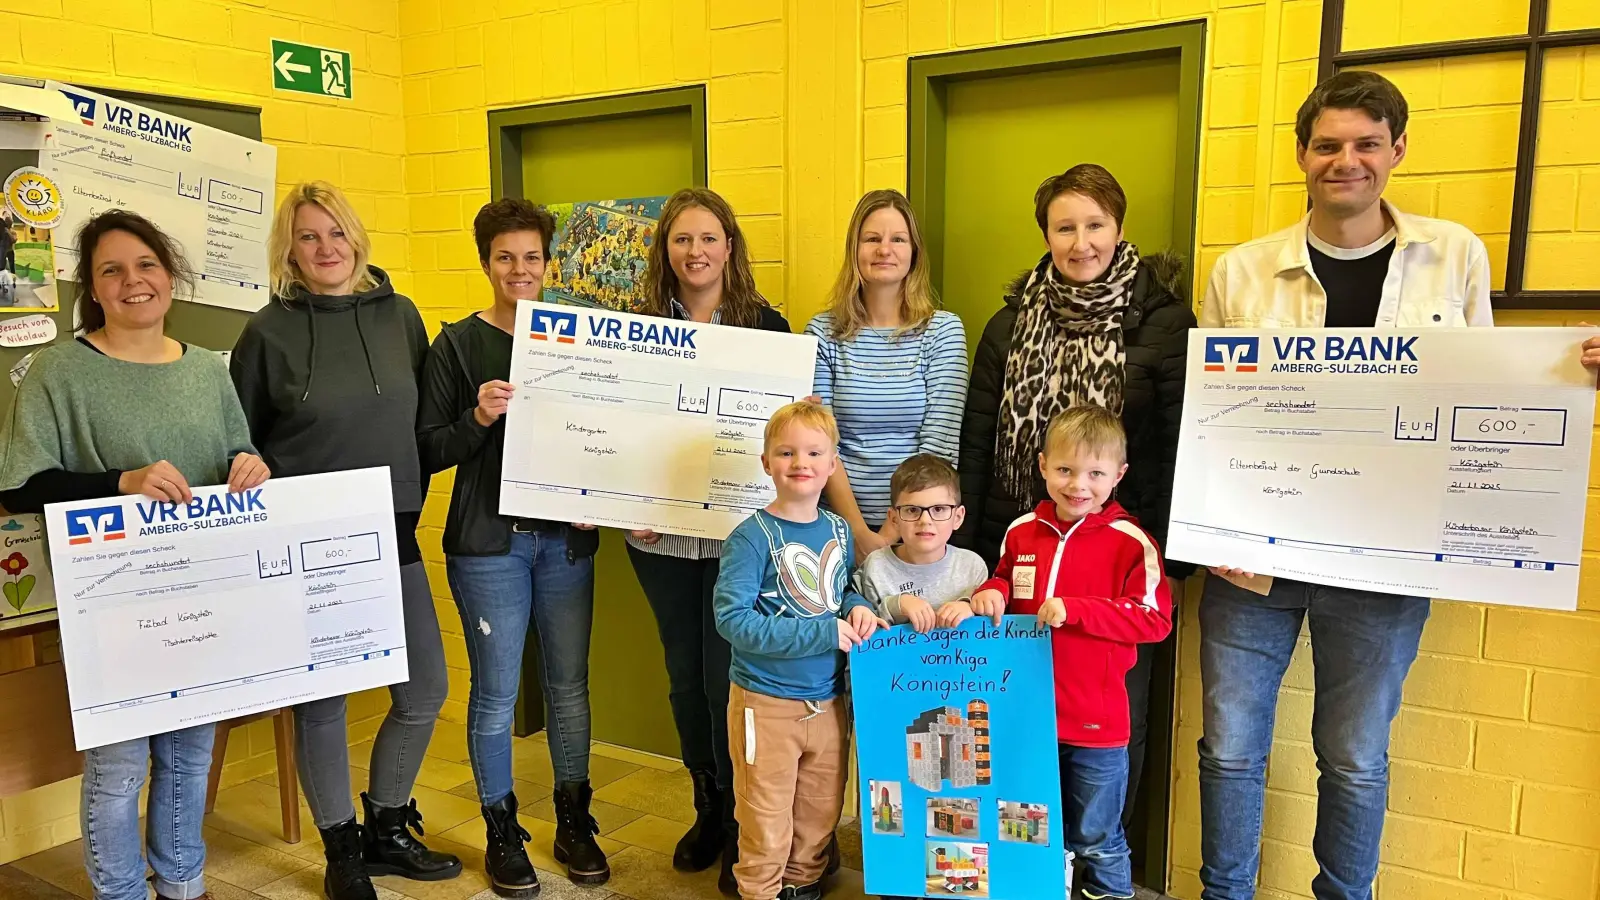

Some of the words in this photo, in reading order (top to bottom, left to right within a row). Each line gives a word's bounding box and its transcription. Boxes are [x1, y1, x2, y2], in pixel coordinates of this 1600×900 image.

[105, 103, 132, 127] VR
[138, 113, 192, 144] BANK
[103, 123, 180, 149] AMBERG-SULZBACH
[181, 182, 199, 192] EUR
[116, 198, 127, 206] der
[26, 206, 52, 216] KLARO
[31, 318, 50, 326] vom
[6, 332, 47, 344] Nikolaus
[588, 316, 622, 340] VR
[628, 321, 697, 349] BANK
[586, 338, 681, 358] AMBERG-SULZBACH
[683, 350, 696, 360] EG
[1272, 336, 1316, 361] VR
[1325, 336, 1419, 362] BANK
[1270, 363, 1397, 374] AMBERG-SULZBACH
[1400, 364, 1418, 374] EG
[681, 396, 706, 406] EUR
[1198, 416, 1208, 424] Nur
[1220, 396, 1259, 415] Verrechnung
[728, 419, 757, 427] Überbringer
[1400, 422, 1433, 432] EUR
[1468, 445, 1510, 454] Überbringer
[1229, 458, 1278, 472] Elternbeirat
[1286, 464, 1302, 472] der
[1460, 459, 1502, 470] Königstein
[1262, 486, 1302, 498] Königstein
[135, 500, 180, 524] VR
[187, 488, 266, 518] BANK
[139, 514, 250, 537] AMBERG-SULZBACH
[254, 512, 268, 522] EG
[1444, 521, 1492, 532] Kinderbasar
[1500, 526, 1538, 538] Königstein
[72, 555, 94, 564] Zahlen
[108, 551, 128, 560] gegen
[152, 545, 176, 554] Scheck
[1016, 554, 1036, 562] JAKO
[262, 559, 288, 570] EUR
[316, 568, 346, 578] Überbringer
[899, 582, 914, 592] BEEP
[73, 590, 86, 600] Nur
[857, 631, 917, 654] Danke
[974, 620, 1000, 640] die
[1004, 620, 1050, 640] Kinder
[920, 654, 952, 666] vom
[955, 648, 988, 672] Kiga
[890, 669, 1012, 700] Königstein!
